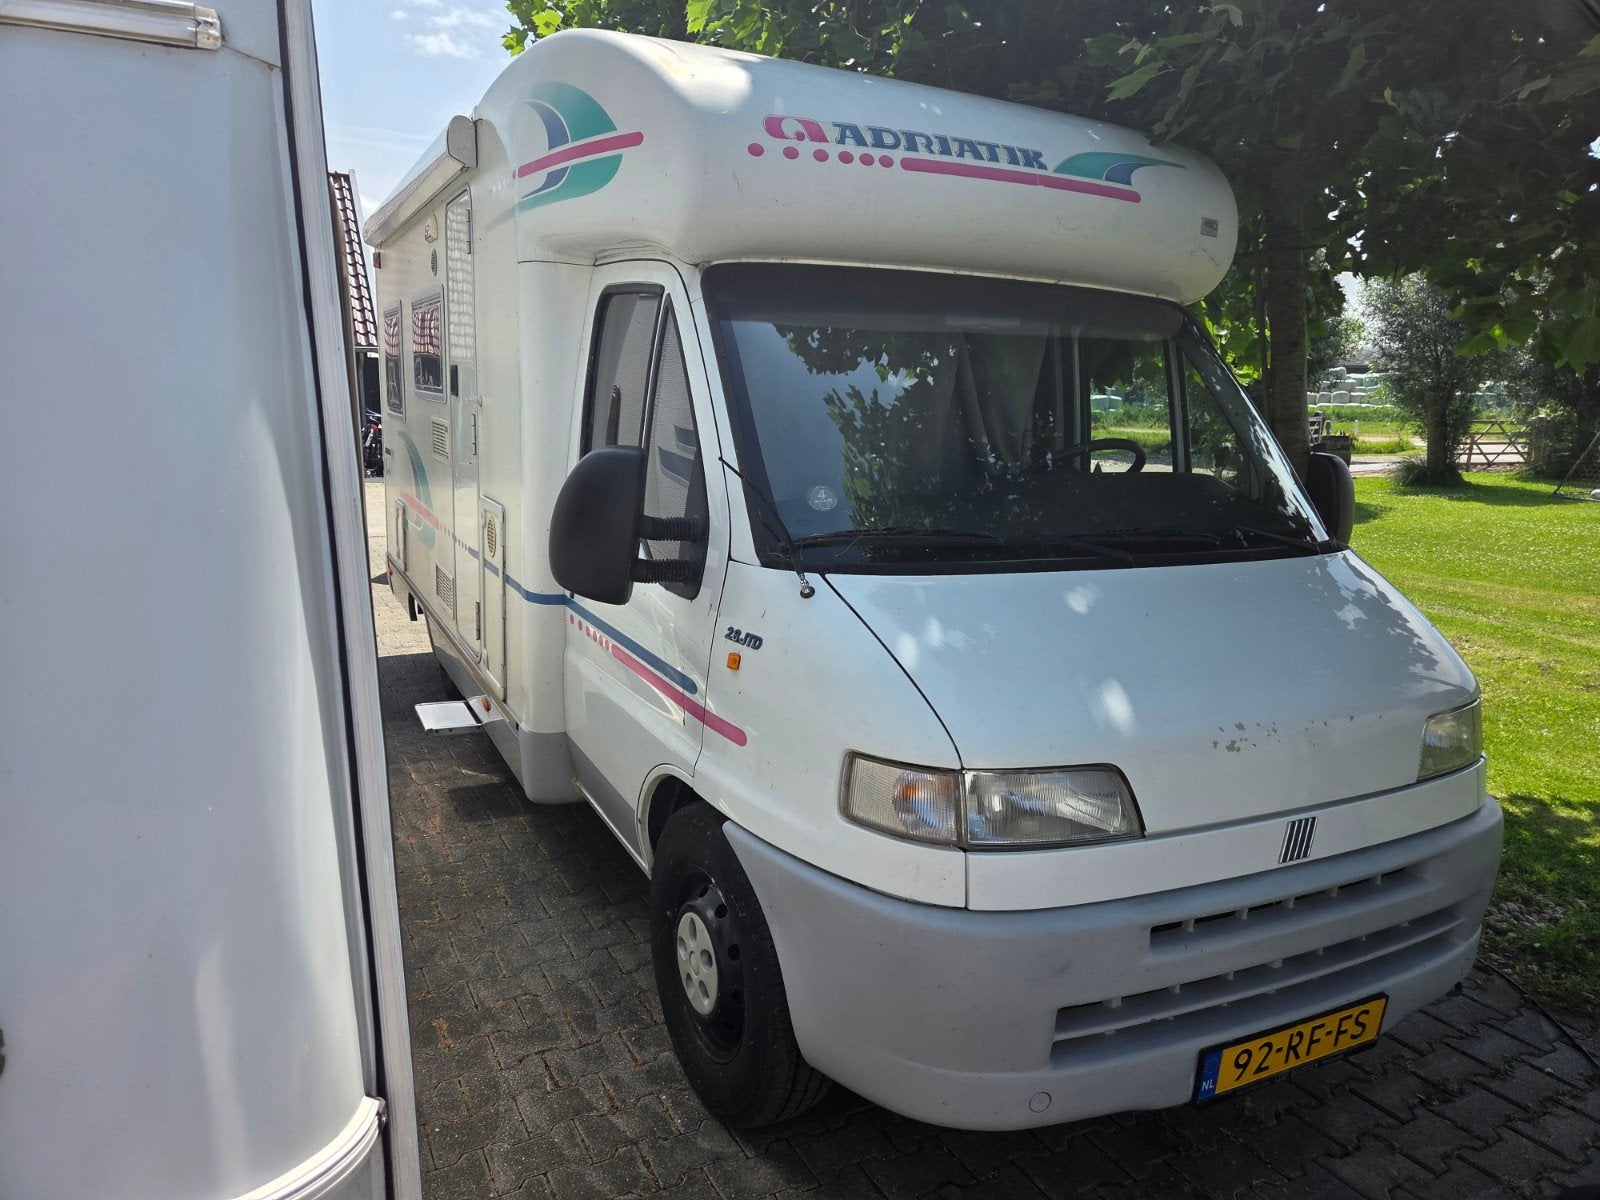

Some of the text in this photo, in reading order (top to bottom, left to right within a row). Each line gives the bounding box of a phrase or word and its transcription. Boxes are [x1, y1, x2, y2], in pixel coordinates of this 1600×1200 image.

[832, 121, 1048, 171] ADRIATIK
[1233, 1009, 1370, 1082] 92-RF-FS
[1201, 1078, 1215, 1091] NL
